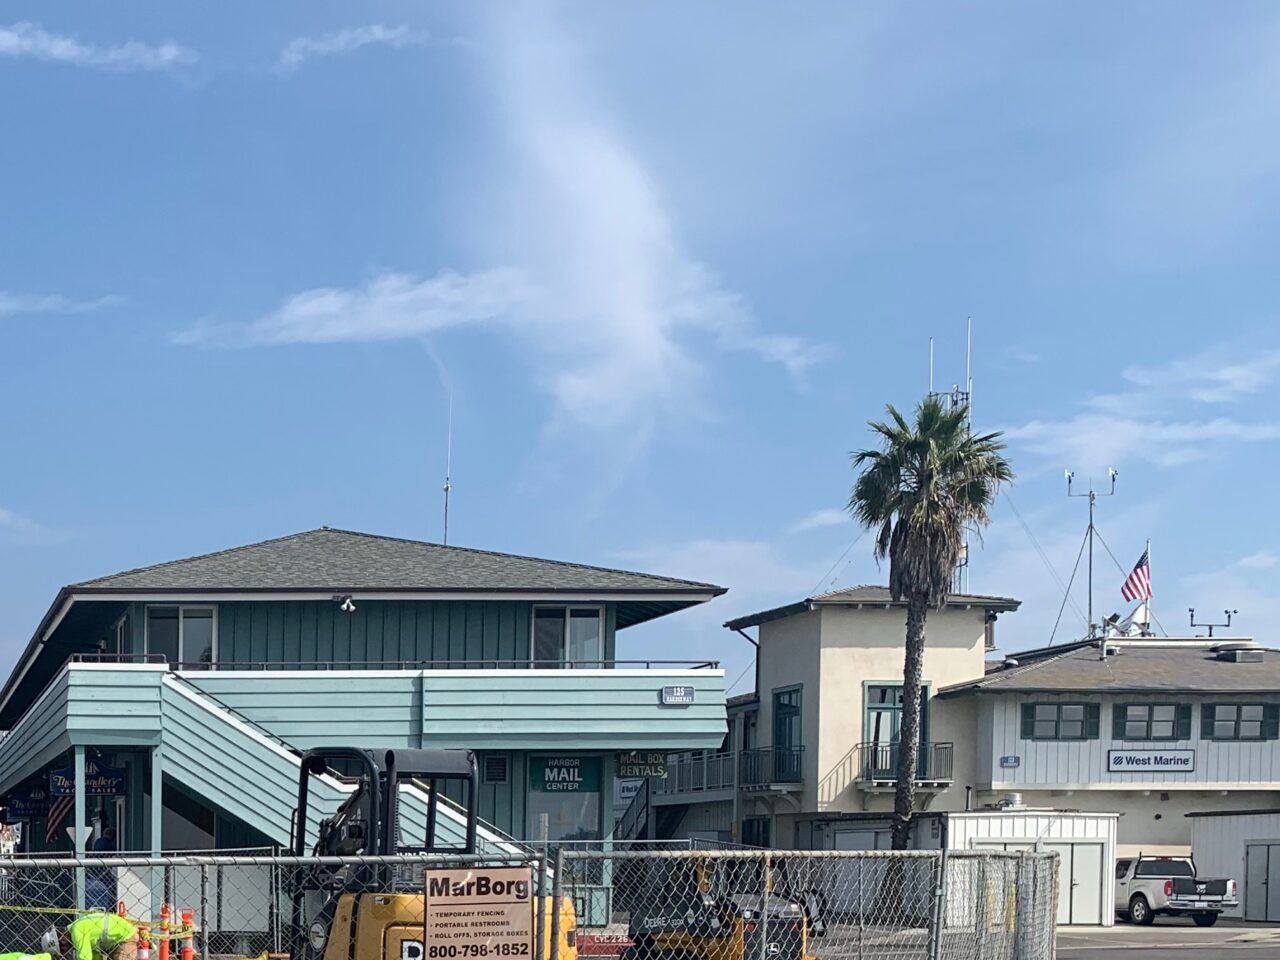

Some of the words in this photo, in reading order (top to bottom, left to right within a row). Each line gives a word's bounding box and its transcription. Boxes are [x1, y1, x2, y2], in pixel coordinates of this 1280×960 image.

[548, 759, 580, 767] HARBOR
[620, 753, 645, 764] MAIL
[647, 753, 664, 764] BOX
[1125, 756, 1151, 765] West
[1154, 755, 1190, 765] Marine
[545, 767, 583, 781] MAIL
[620, 765, 664, 776] RENTALS
[53, 775, 72, 787] The
[546, 782, 579, 790] CENTER
[429, 876, 529, 899] MarBorg
[594, 935, 609, 943] CVC
[429, 943, 529, 958] 800-798-1852
